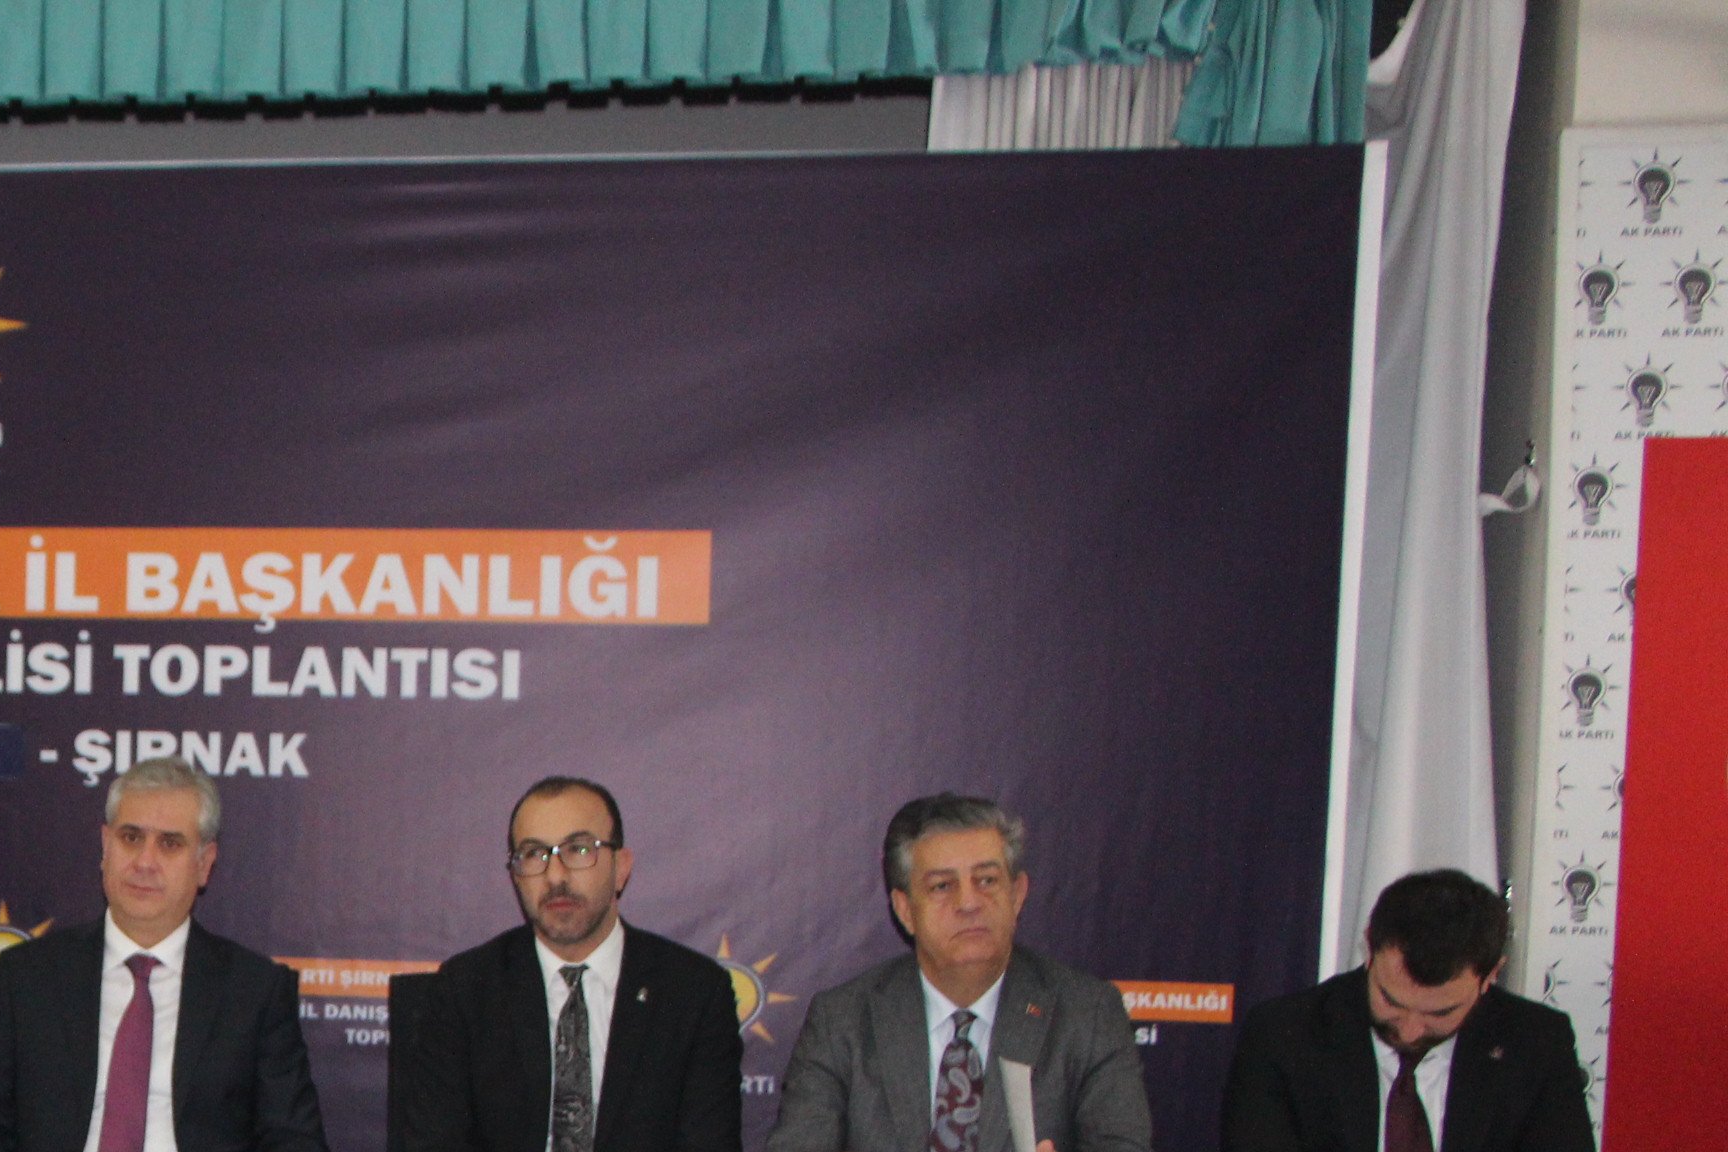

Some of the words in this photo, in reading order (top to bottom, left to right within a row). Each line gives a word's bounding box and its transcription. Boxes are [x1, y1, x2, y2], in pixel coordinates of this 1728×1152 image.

[25, 535, 100, 613] İL
[125, 535, 661, 634] BAŞKANLIĞI
[112, 644, 525, 702] TOPLANTISI
[72, 729, 310, 787] ŞIRNAK
[340, 968, 390, 990] ŞIRN
[324, 1002, 389, 1026] DANIŞ
[1122, 989, 1228, 1014] ŞKANLIĞI
